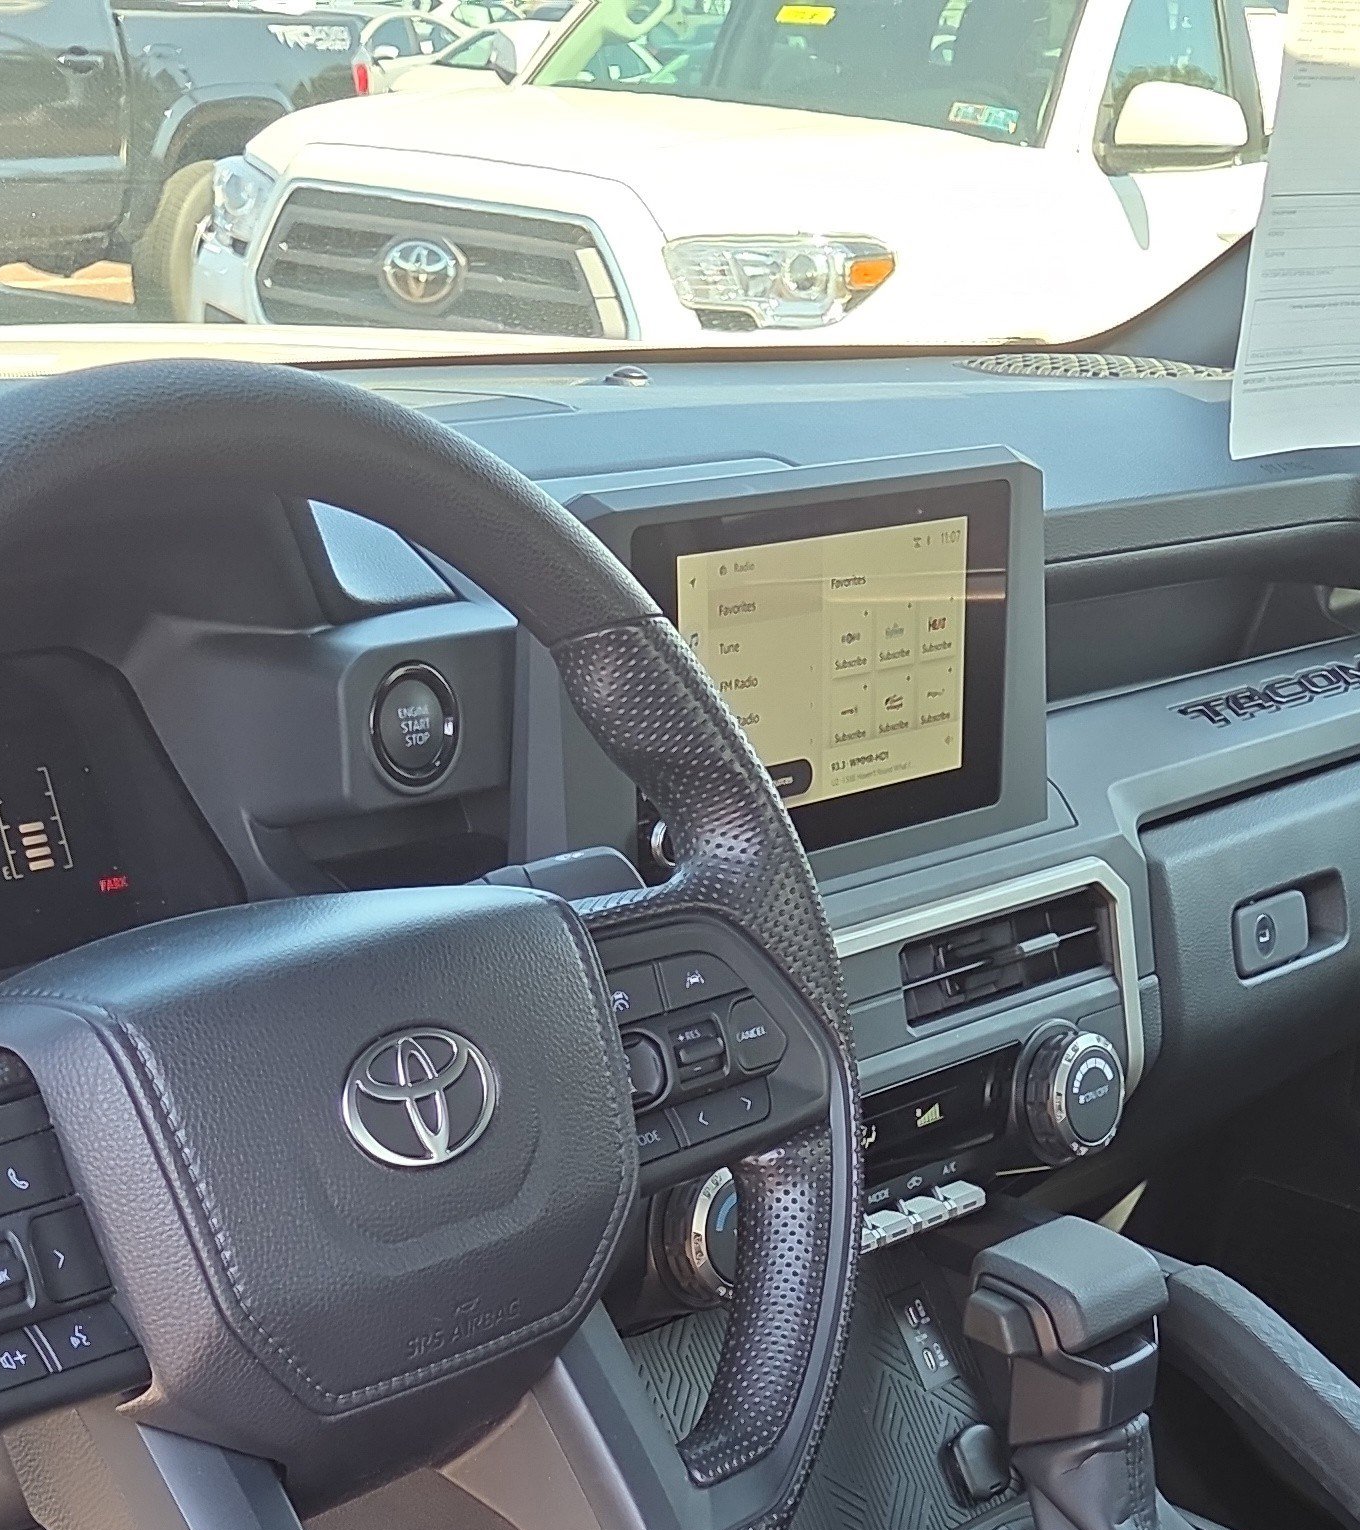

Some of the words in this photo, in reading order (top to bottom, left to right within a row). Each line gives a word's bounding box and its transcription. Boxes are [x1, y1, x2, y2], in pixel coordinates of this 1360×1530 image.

[734, 562, 756, 573] Radio
[831, 575, 867, 590] Favorites
[718, 601, 757, 617] Favorites
[719, 642, 740, 655] Tune
[921, 640, 953, 654] Subscribe
[878, 648, 911, 663] Subscribe
[835, 656, 868, 671] Subscribe
[734, 675, 759, 690] Radio
[400, 718, 430, 734] START
[920, 711, 951, 726] Subscribe
[878, 720, 909, 734] Subscribe
[405, 732, 431, 748] STOP
[834, 729, 867, 744] Subscribe
[2, 865, 13, 881] E
[736, 1025, 767, 1043] CANCEL
[637, 1129, 661, 1147] ODE
[451, 1297, 521, 1344] AIRBAG
